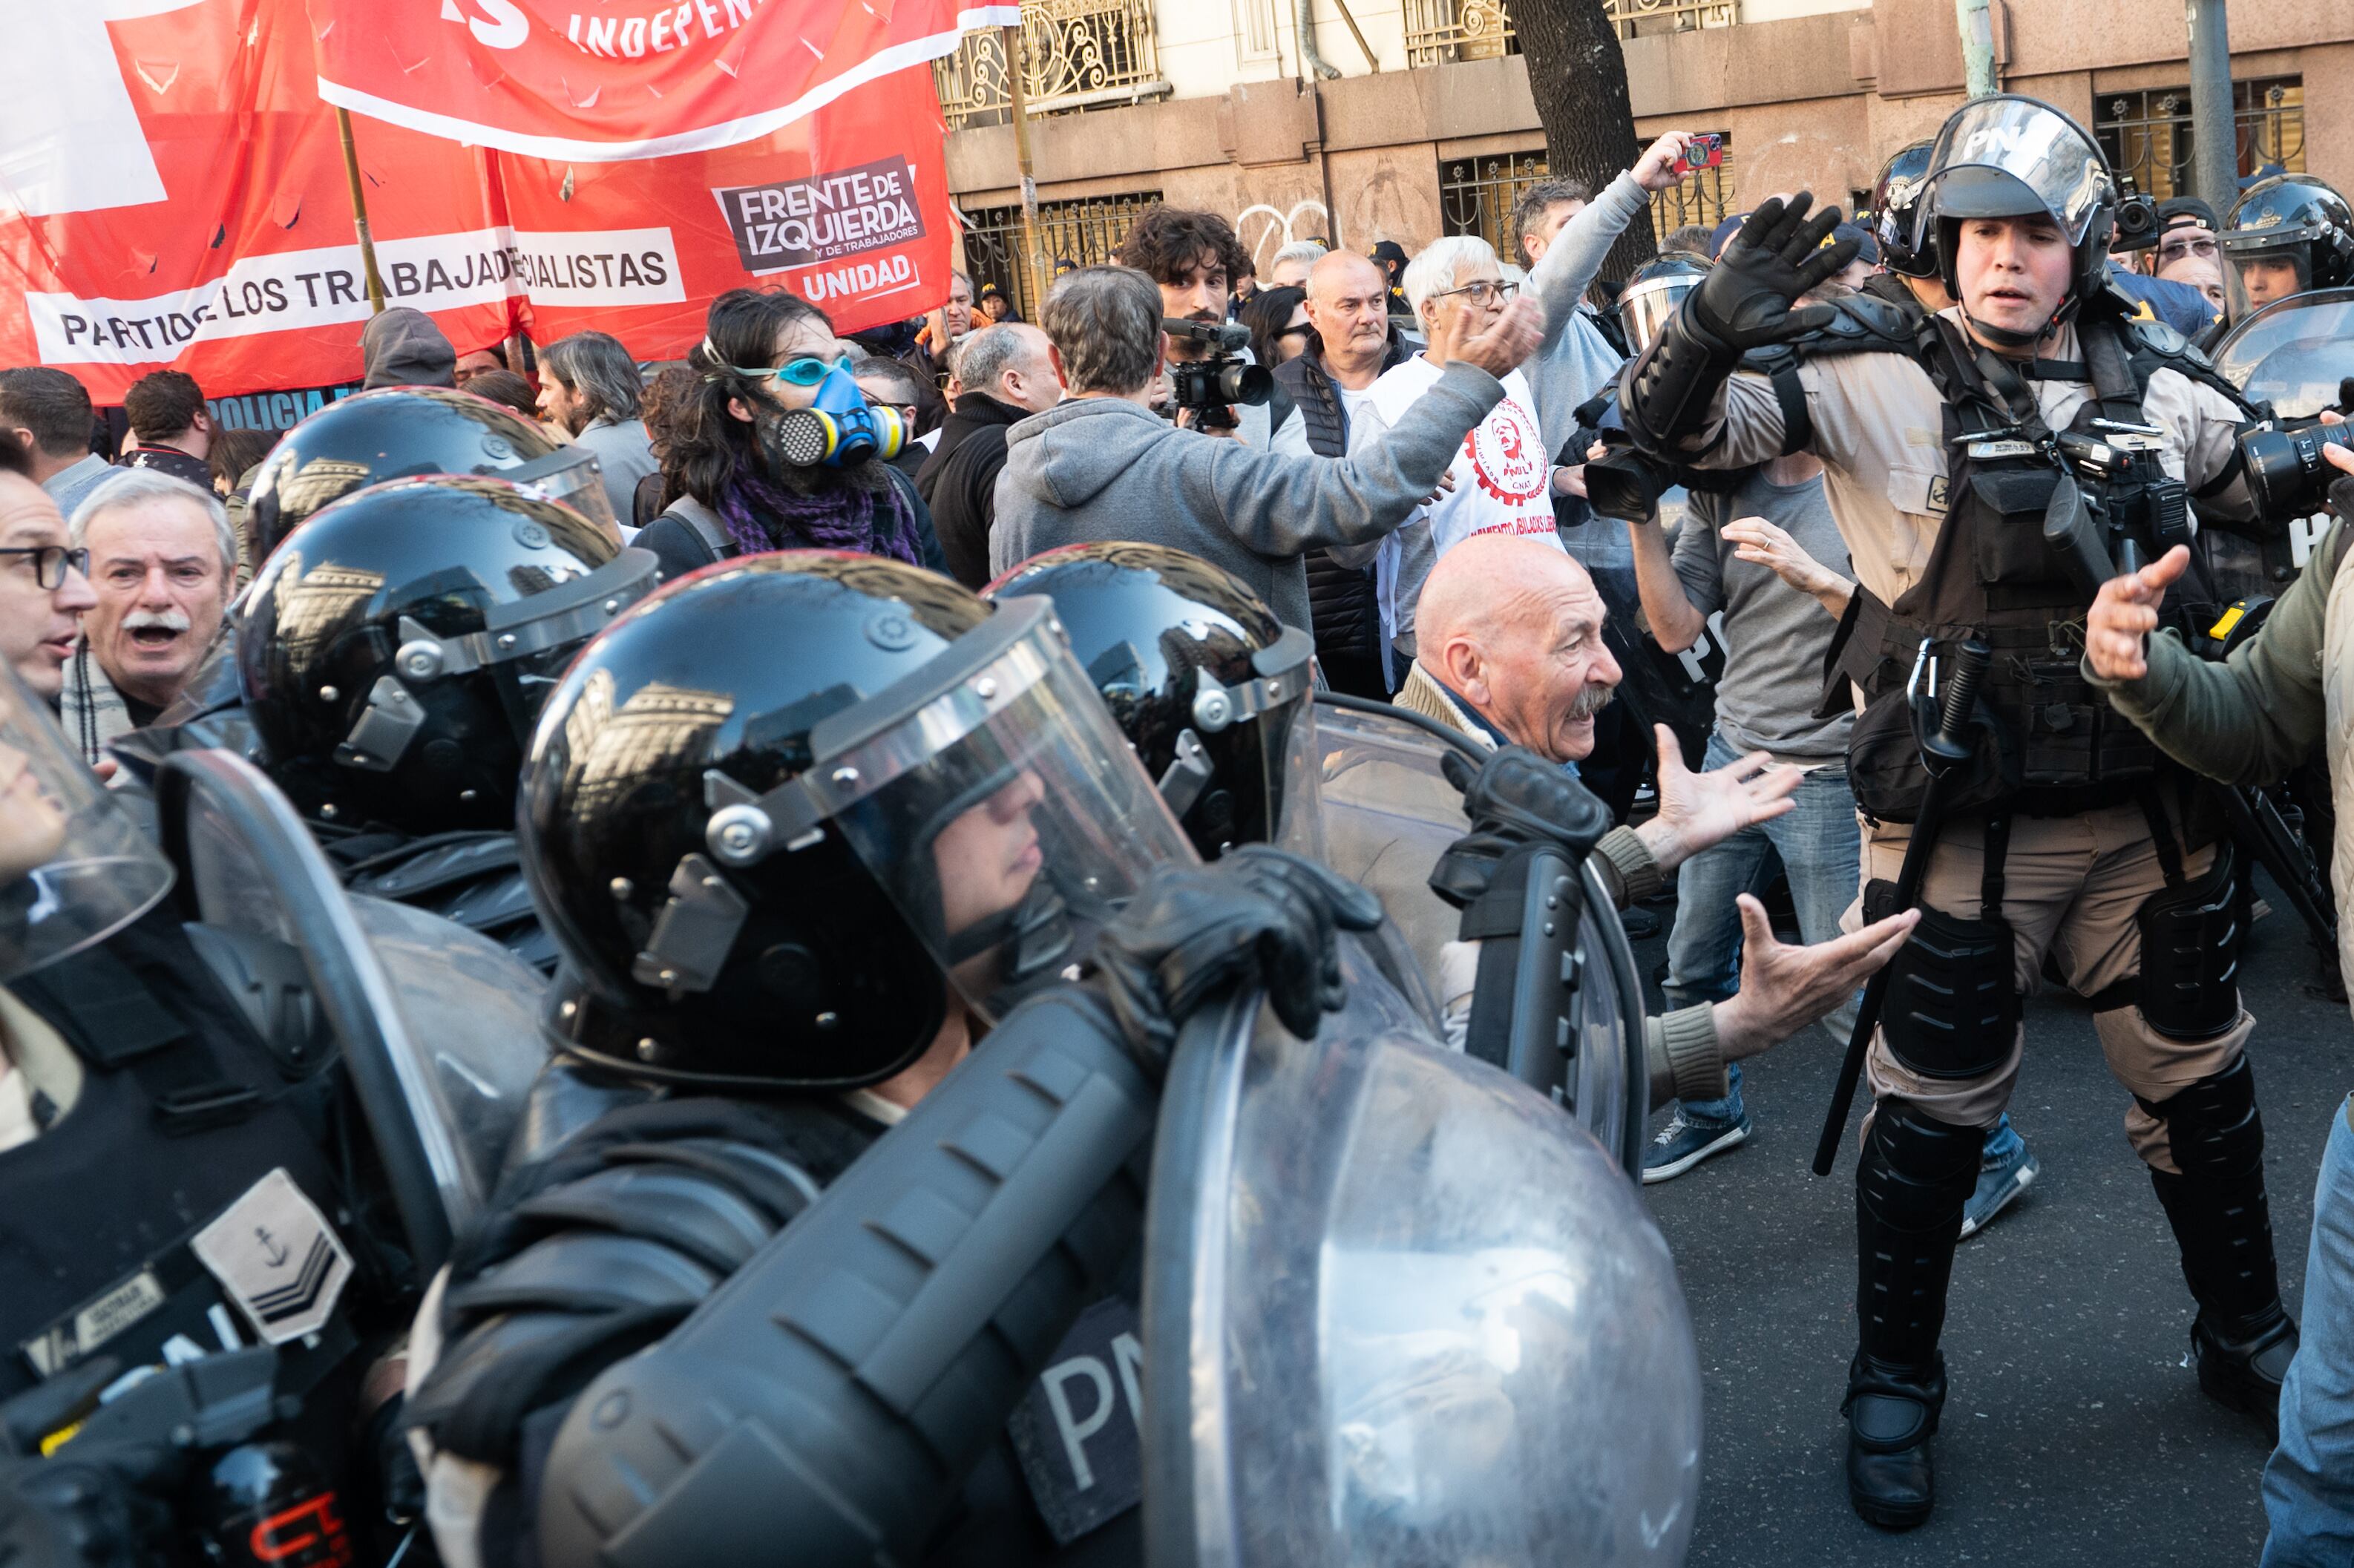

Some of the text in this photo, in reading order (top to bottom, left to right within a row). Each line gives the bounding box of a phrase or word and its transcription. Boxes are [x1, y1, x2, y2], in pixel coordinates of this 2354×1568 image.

[568, 0, 760, 58] INDEPEN
[738, 170, 902, 223] FRENTE DE
[1856, 210, 1871, 220] PF
[745, 197, 917, 256] IZQUIERDA
[815, 225, 919, 258] Y DE TRABAJADORES
[222, 278, 289, 318] LOS
[521, 251, 667, 289] CIALISTAS
[802, 255, 911, 301] UNIDAD
